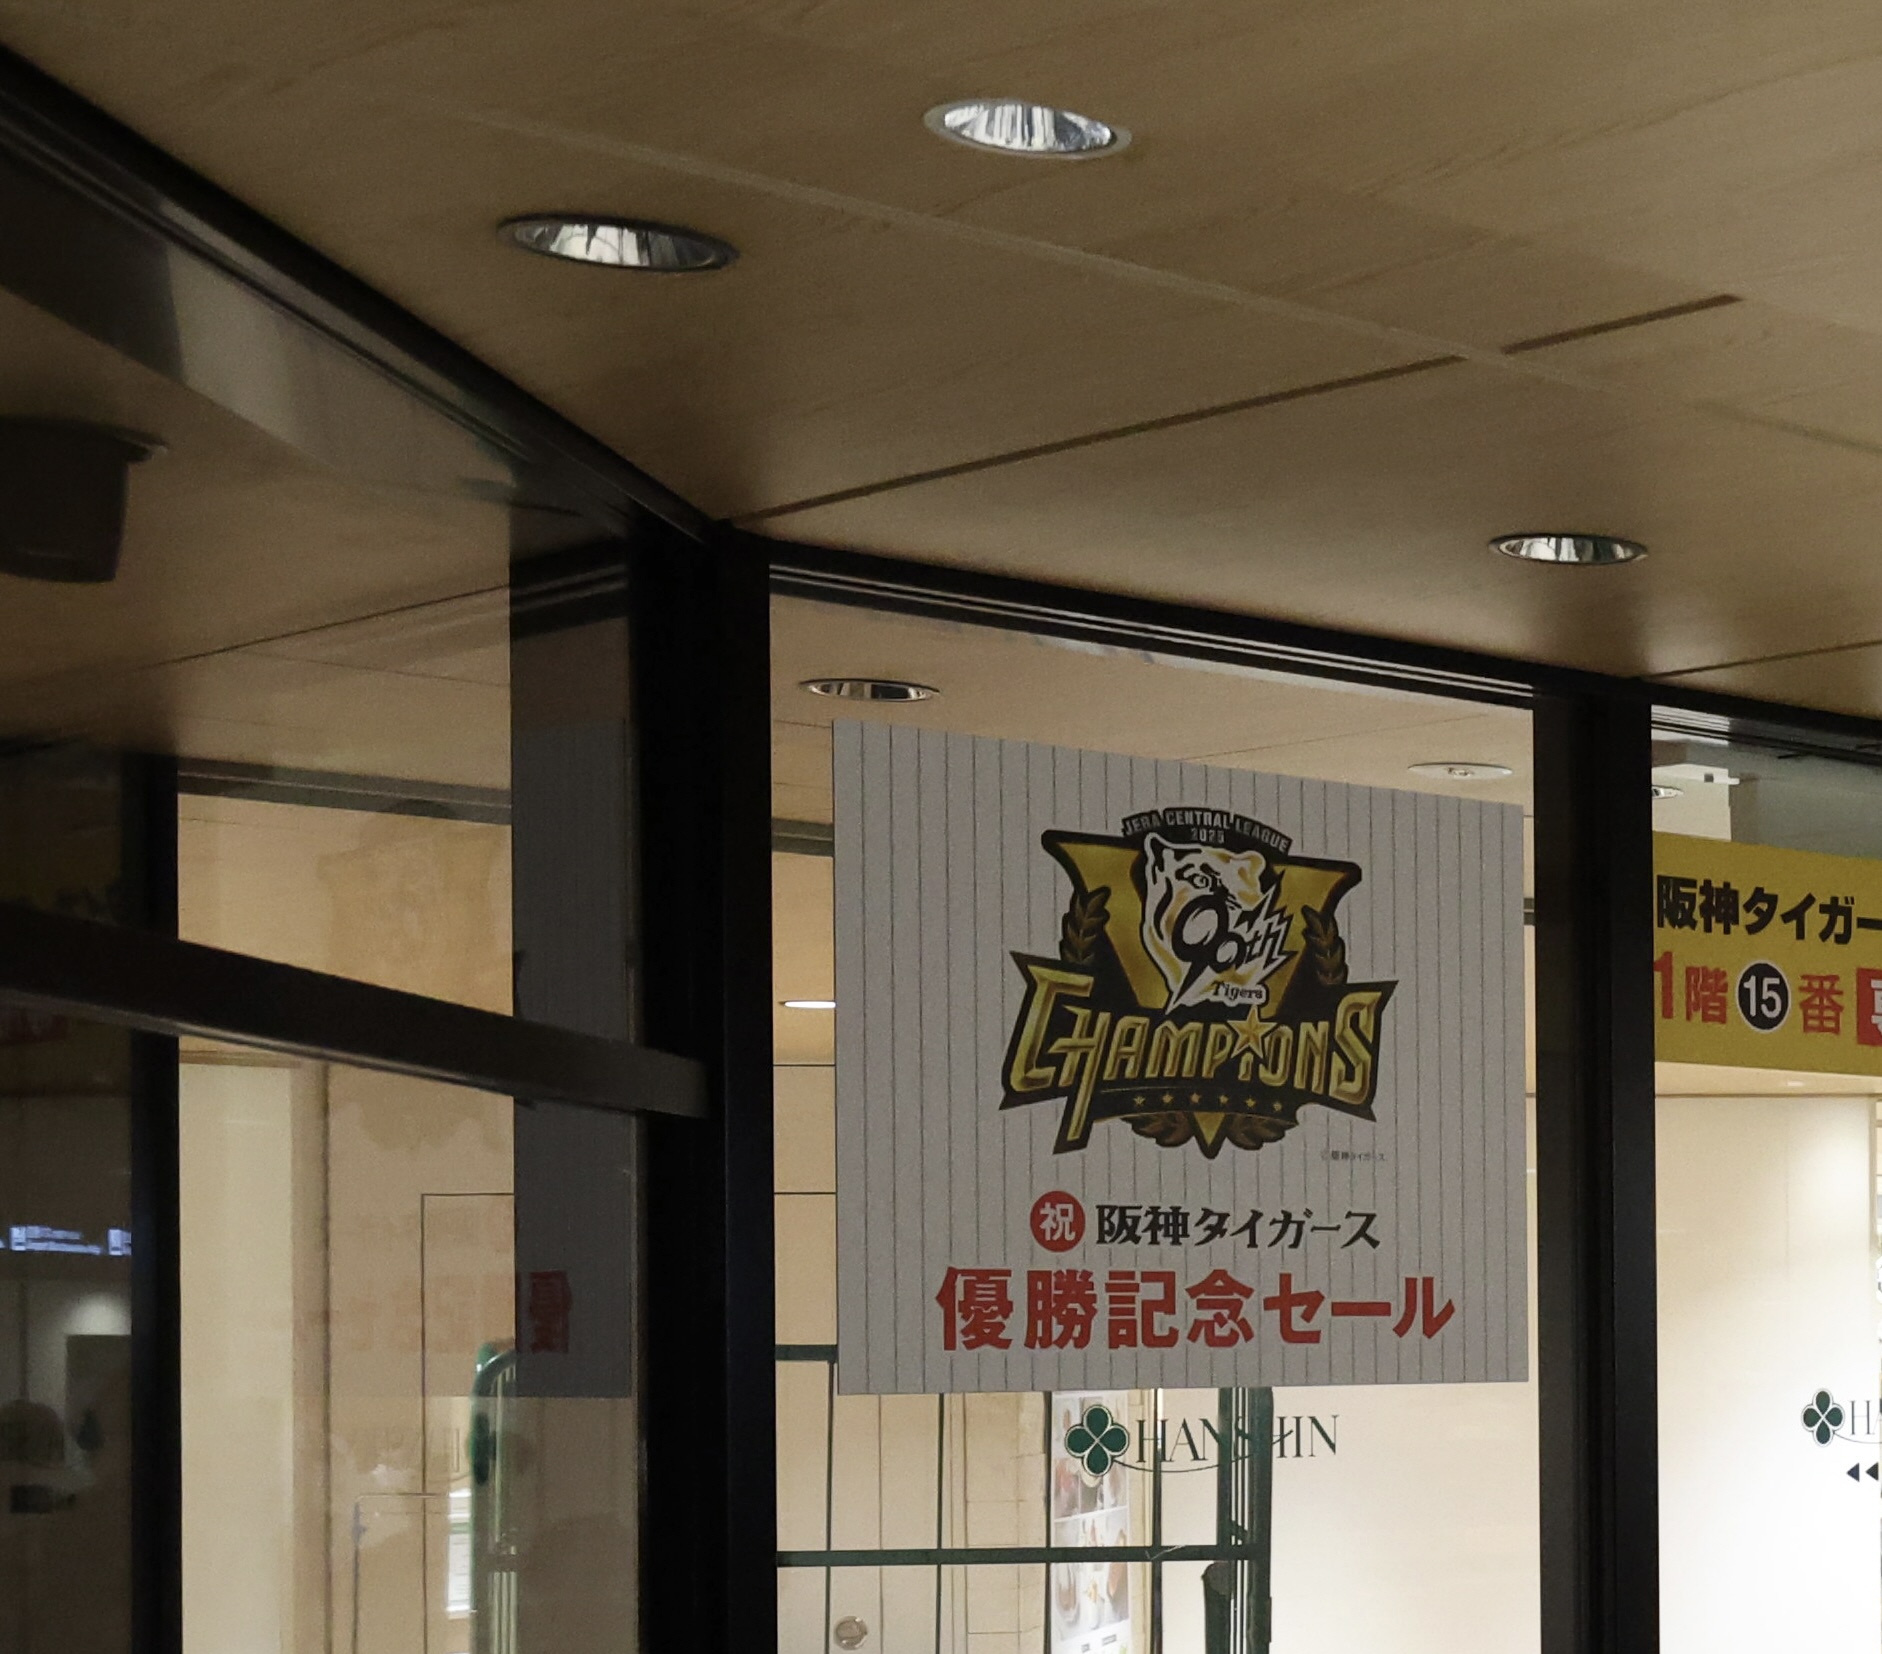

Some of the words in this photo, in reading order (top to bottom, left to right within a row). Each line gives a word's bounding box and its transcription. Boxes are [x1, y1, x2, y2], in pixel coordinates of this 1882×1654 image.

[1124, 810, 1162, 835] JERA
[1165, 807, 1231, 828] CENTRAL
[1234, 815, 1290, 851] LEAGUE
[1212, 981, 1263, 1002] Tigers
[1012, 965, 1381, 1140] CHAMPIONS
[1095, 1204, 1381, 1249] 阪神タイガース
[935, 1266, 1455, 1351] 優勝記念セール
[1136, 1413, 1339, 1463] HANSHIN
